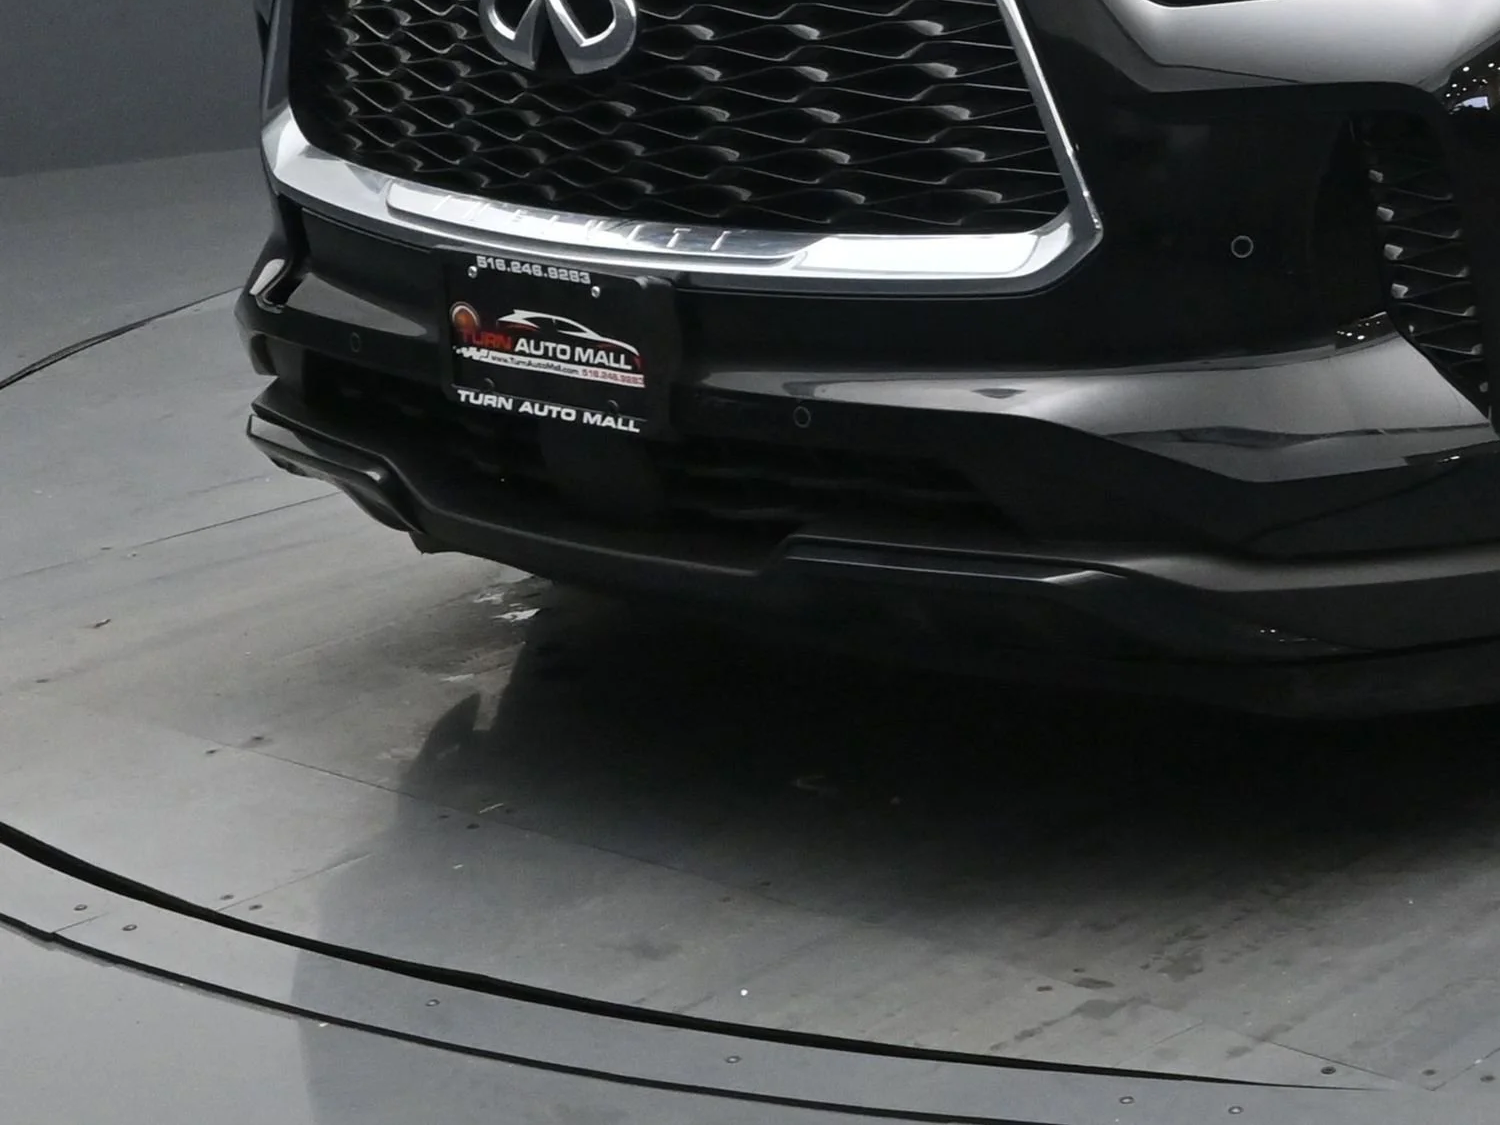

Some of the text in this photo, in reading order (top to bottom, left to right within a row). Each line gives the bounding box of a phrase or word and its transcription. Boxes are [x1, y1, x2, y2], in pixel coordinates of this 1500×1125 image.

[460, 327, 633, 370] TURN AUTO MALL
[457, 389, 640, 433] TURN AUTO MALL
